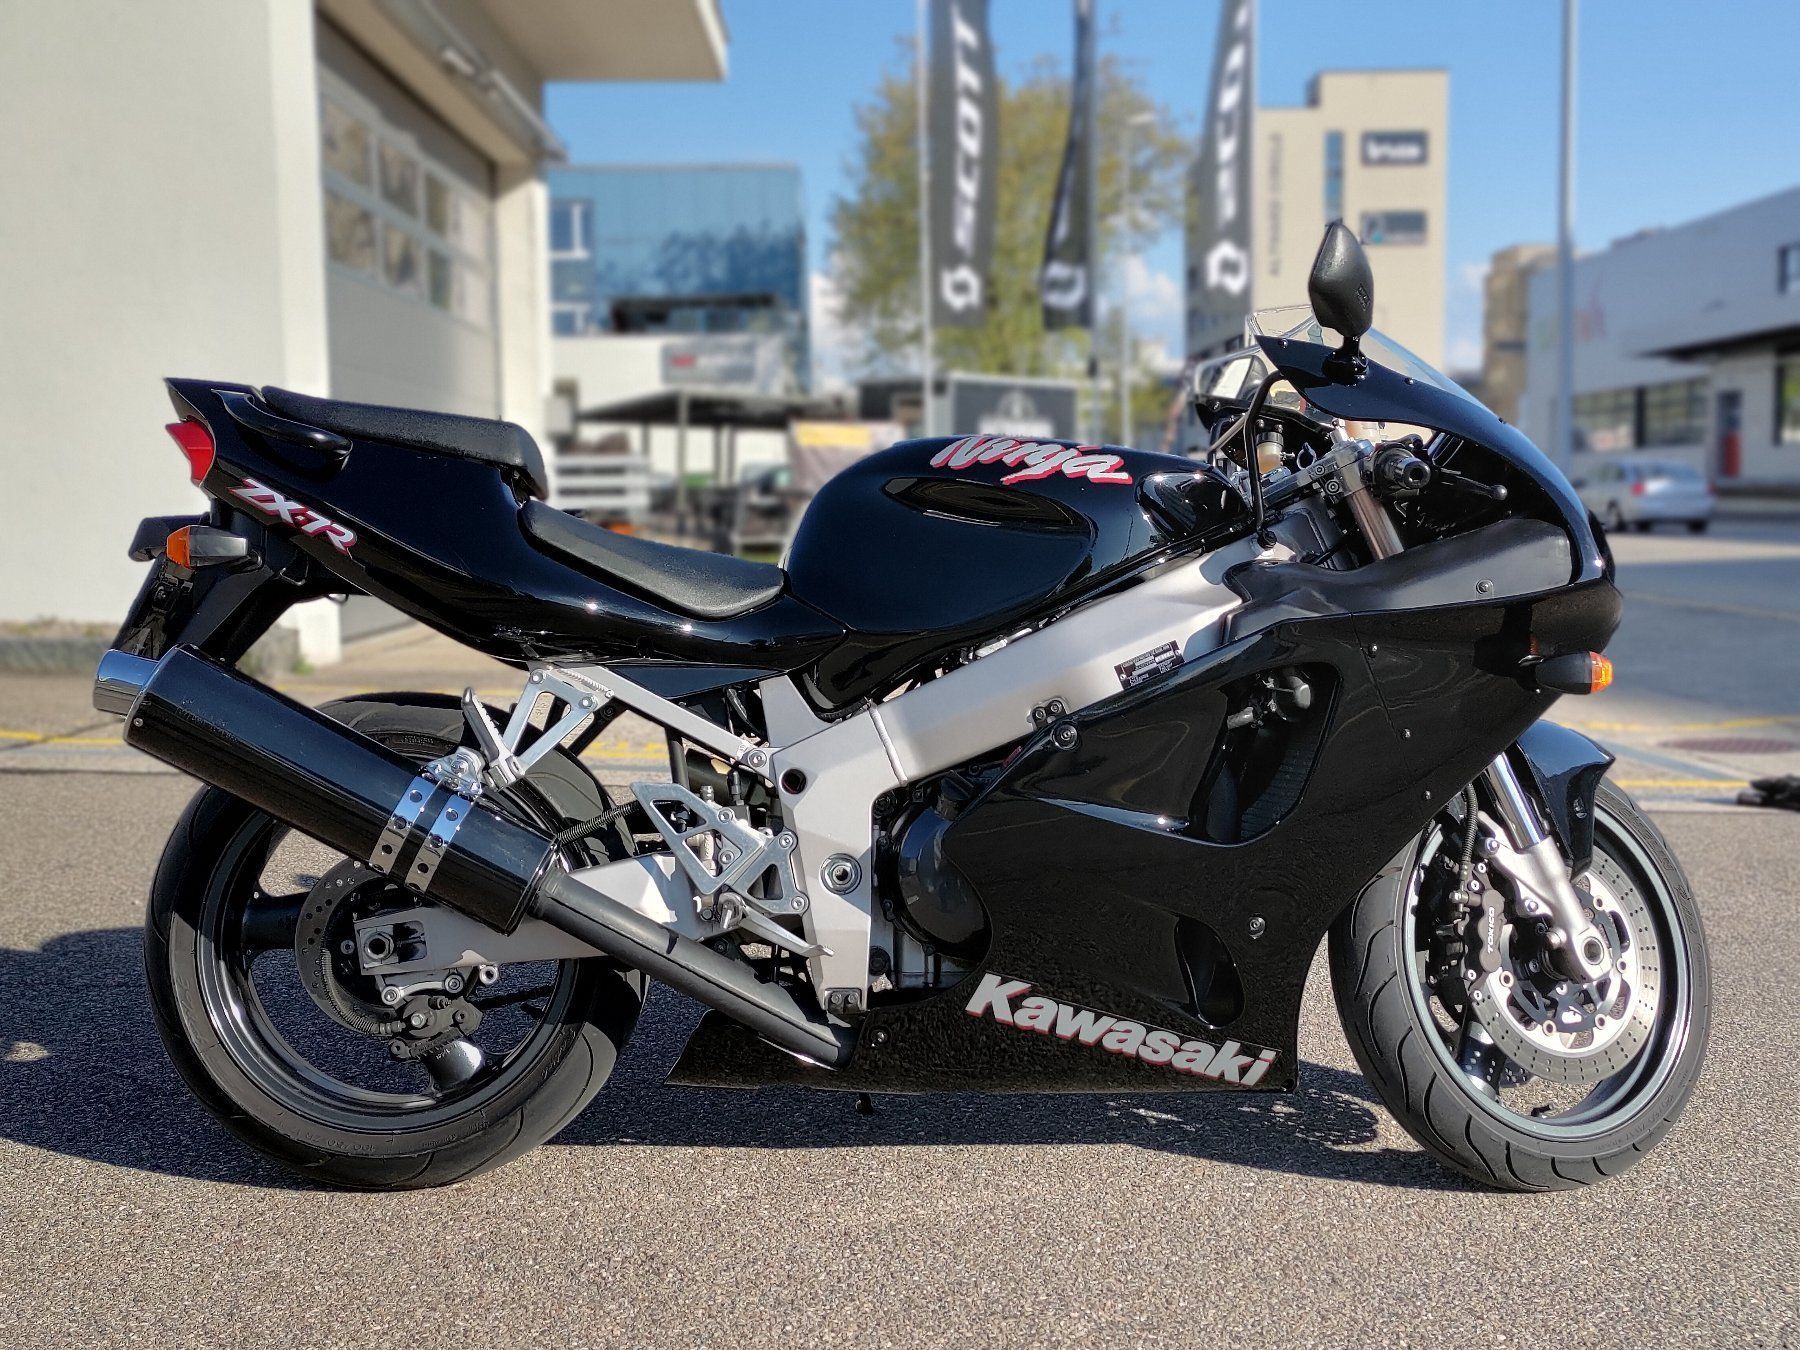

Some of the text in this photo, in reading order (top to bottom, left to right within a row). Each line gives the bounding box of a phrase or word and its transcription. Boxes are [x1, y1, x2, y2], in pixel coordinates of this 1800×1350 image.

[952, 4, 982, 257] SCOTT
[930, 436, 1133, 485] Ninja
[1487, 905, 1495, 954] TOKICO
[965, 971, 1278, 1087] Kawasaki
